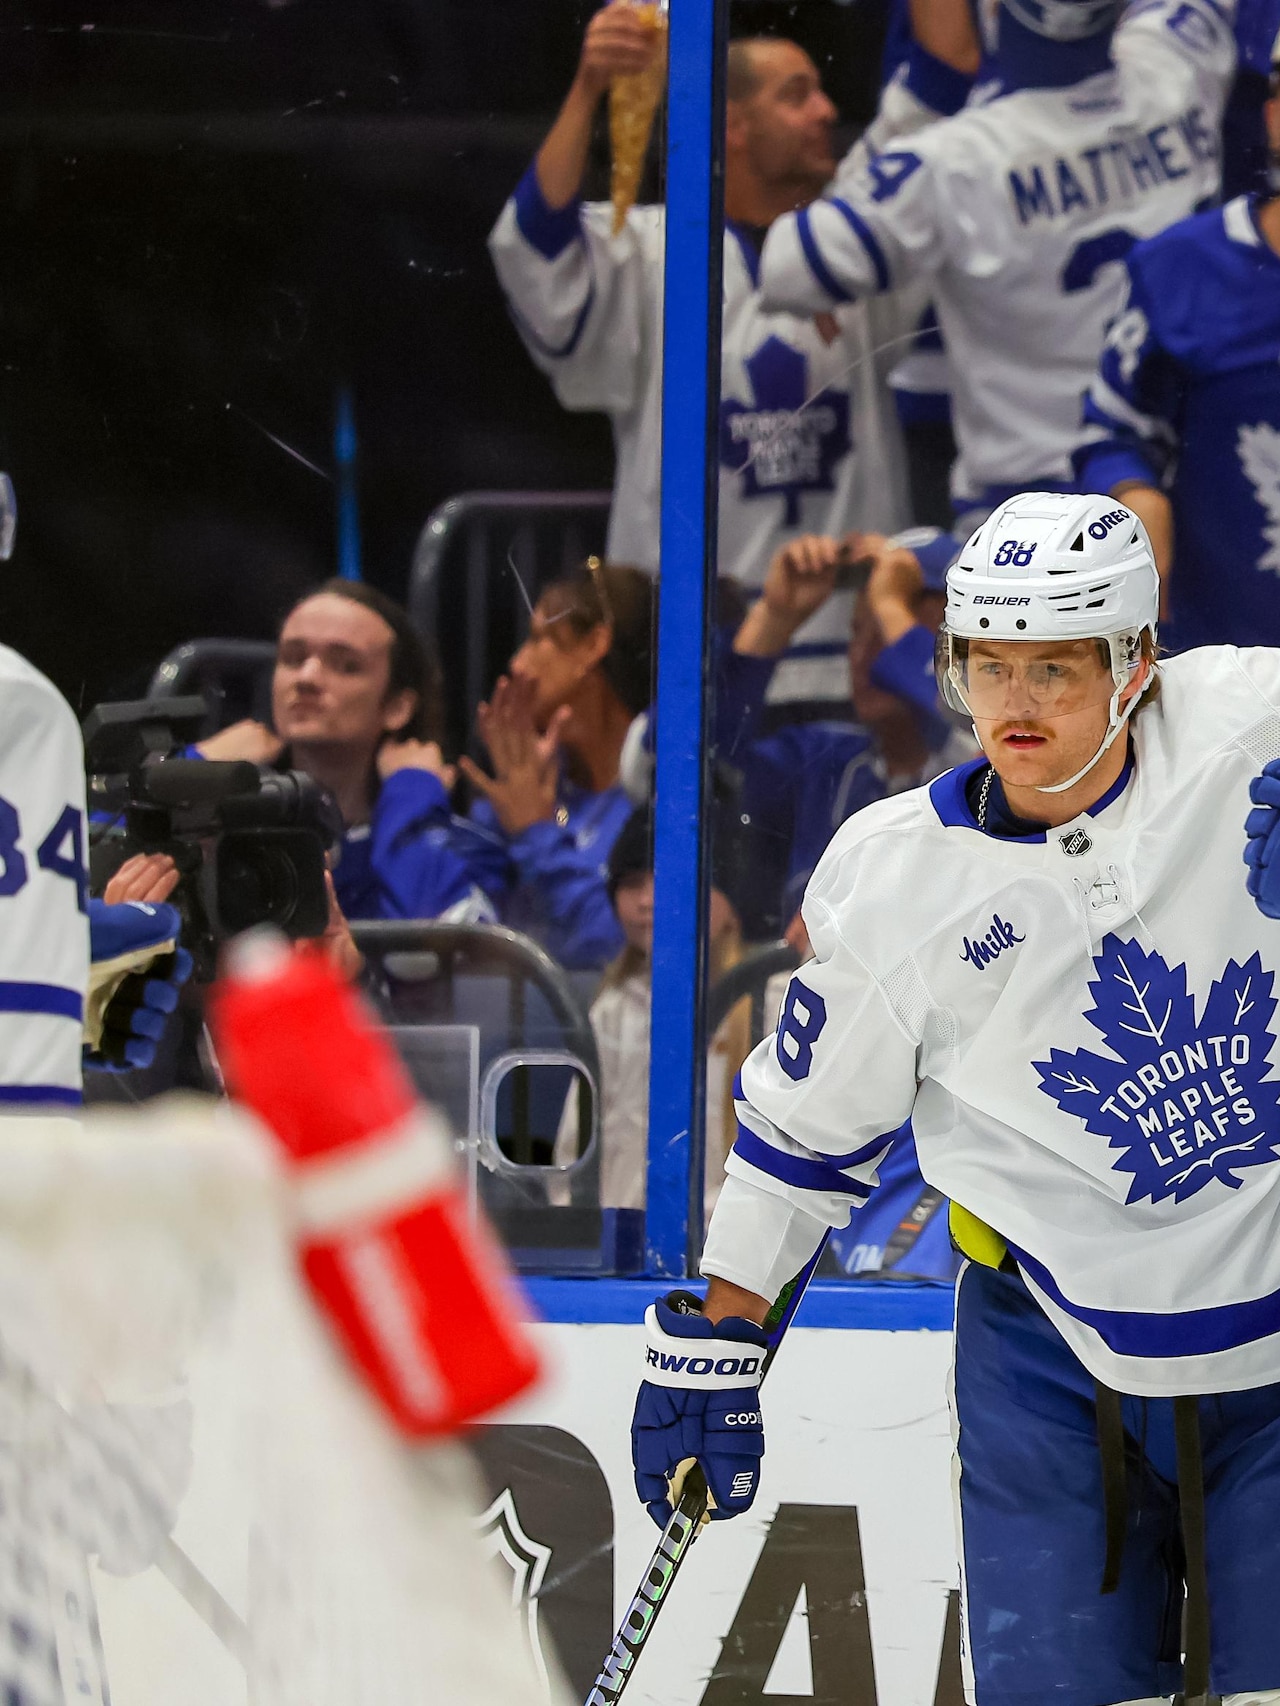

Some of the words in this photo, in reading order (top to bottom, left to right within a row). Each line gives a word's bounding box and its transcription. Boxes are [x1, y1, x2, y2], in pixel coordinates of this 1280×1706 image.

[1088, 509, 1130, 540] OREO
[993, 540, 1038, 567] 88
[973, 595, 1031, 606] BAUER
[959, 913, 1026, 970] Milk
[1099, 1034, 1250, 1122] TORONTO
[1135, 1067, 1244, 1138] MAPLE
[1149, 1097, 1256, 1168] LEAFS
[645, 1344, 760, 1376] RWOOD
